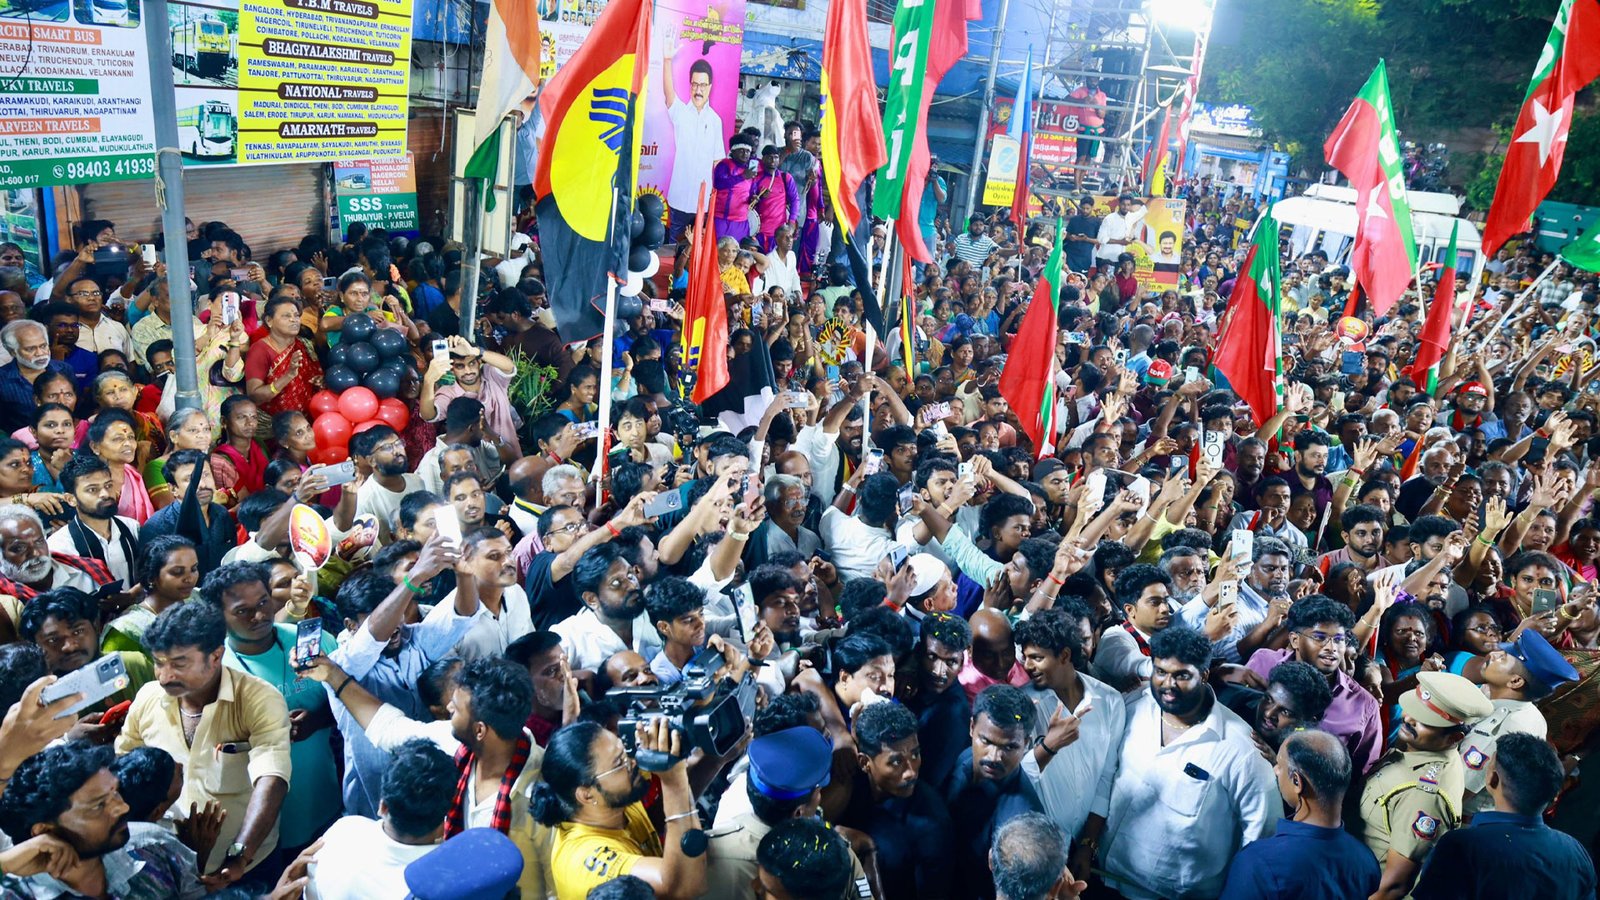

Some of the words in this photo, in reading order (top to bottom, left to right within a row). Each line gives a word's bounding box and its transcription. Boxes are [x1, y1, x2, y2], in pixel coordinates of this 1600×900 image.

[243, 3, 285, 17] BANGALORE,
[286, 11, 324, 23] HYDERABAD,
[334, 2, 373, 16] TRAVELS
[255, 15, 293, 28] NAGERCOIL,
[295, 21, 333, 33] TIRUNELVELI,
[33, 27, 72, 41] SMART
[73, 30, 96, 43] BUS
[256, 25, 299, 38] COIMBATORE,
[301, 31, 331, 42] POLLACHI,
[37, 45, 90, 56] TRIVANDRUM,
[91, 48, 135, 57] ERNAKULAM
[268, 40, 361, 61] BHAGIYALAKSHMI
[361, 52, 393, 64] TRAVELS
[38, 55, 95, 66] TIRUCHENDUR,
[96, 58, 134, 67] TUTICORIN
[247, 58, 297, 70] RAMESWARAM,
[298, 63, 338, 73] PARAMAKUDI,
[340, 66, 371, 75] KARAIKUDI,
[34, 66, 87, 77] KODAIKANAL,
[88, 68, 134, 78] VELANKANNI
[248, 68, 281, 79] TANJORE,
[282, 71, 324, 81] PATTUKOTTAI,
[27, 80, 75, 92] TRAVELS
[285, 84, 342, 99] NATIONAL
[342, 90, 374, 99] TRAVELS
[52, 97, 95, 106] KARAIKUDI,
[97, 97, 142, 105] ARANTHANGI
[253, 100, 282, 109] MADURAI,
[30, 107, 81, 116] THIRUVARUR,
[83, 107, 137, 115] NAGAPATTINAM
[207, 104, 231, 113] YBM
[244, 110, 266, 119] SALEM,
[45, 120, 90, 132] TRAVELS
[281, 124, 346, 136] AMARNATH
[346, 126, 377, 135] TRAVELS
[14, 138, 40, 146] THENI,
[42, 137, 63, 145] BODI,
[65, 135, 100, 144] CUMBUM,
[101, 134, 144, 143] ELAYANGUDI
[22, 147, 53, 157] KARUR,
[54, 145, 98, 155] NAMAKKAL,
[99, 143, 154, 153] MUDUKULATHUR
[245, 142, 274, 151] TENKASI,
[276, 142, 320, 150] RAYAPALAYAM,
[245, 152, 293, 161] VILATHIKULAM,
[67, 160, 111, 179] 98403
[114, 157, 155, 175] 41939
[371, 164, 409, 172] BANGALORE
[24, 174, 39, 184] 017
[349, 197, 383, 212] SSS
[343, 212, 383, 222] THURAIYUR
[387, 210, 415, 220] P.VELUR
[390, 220, 413, 229] KARUR
